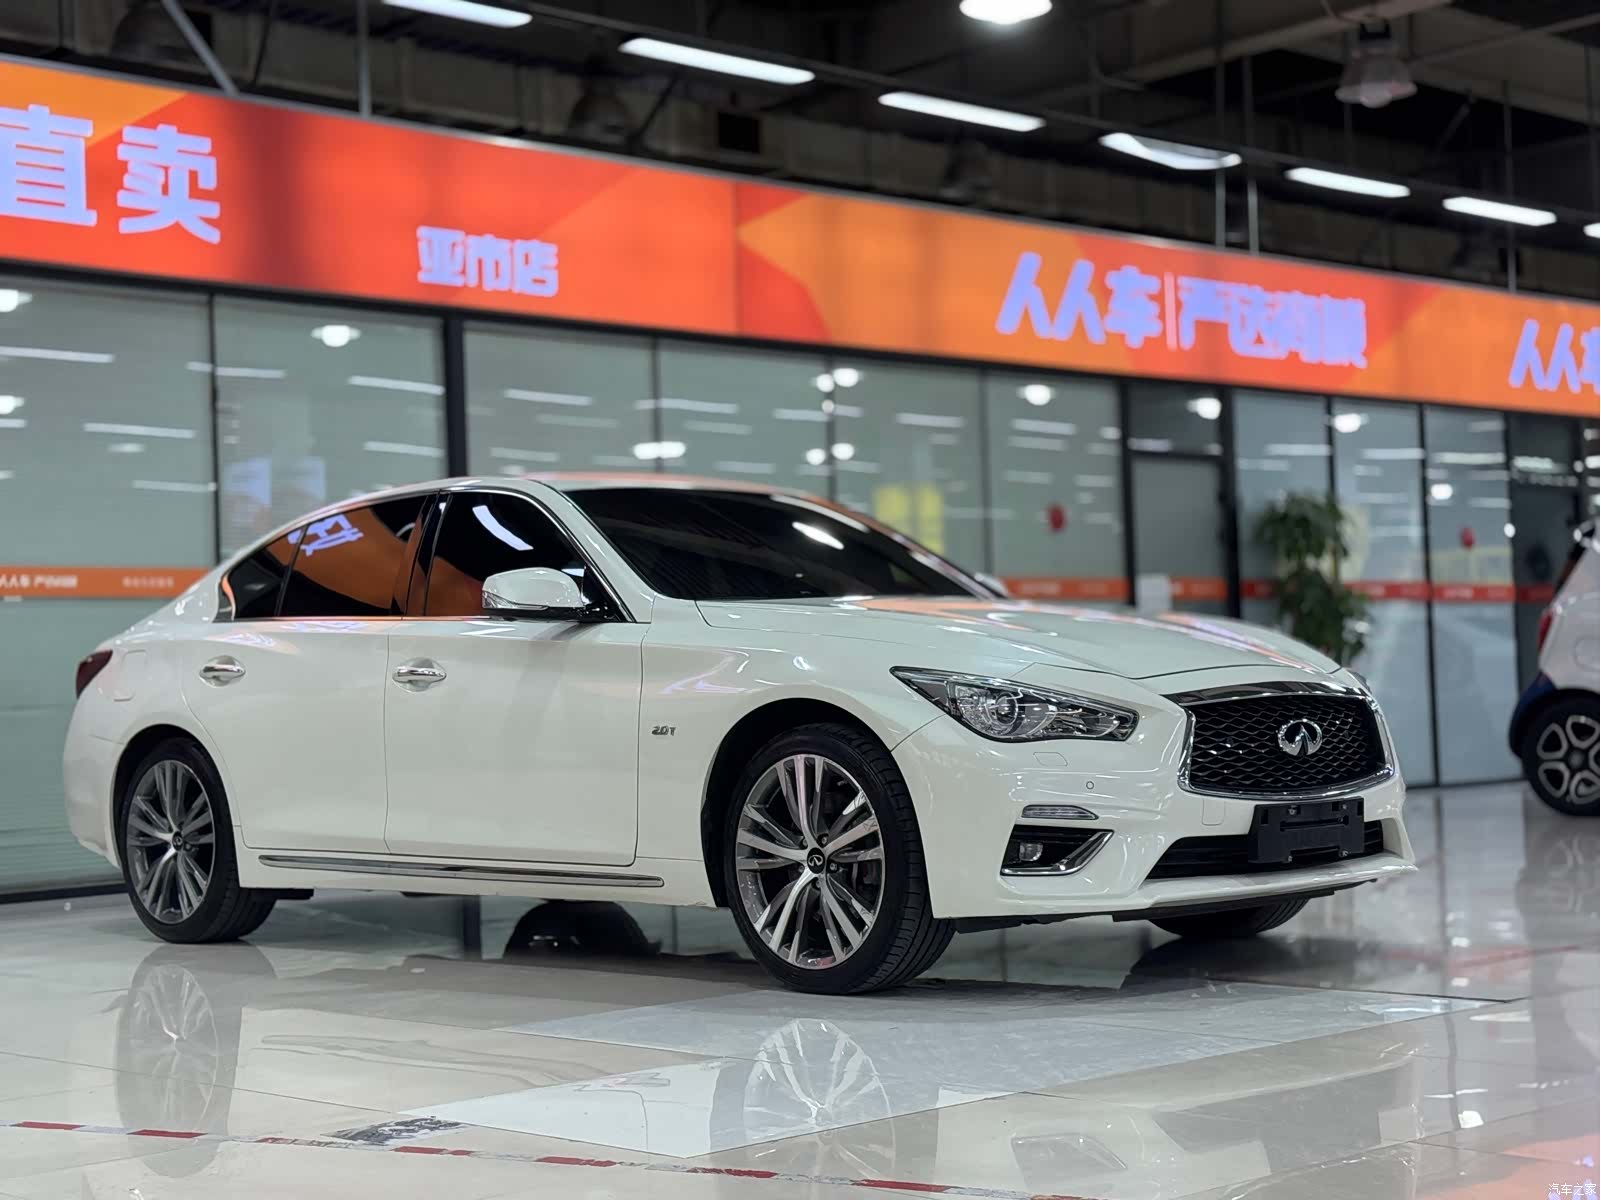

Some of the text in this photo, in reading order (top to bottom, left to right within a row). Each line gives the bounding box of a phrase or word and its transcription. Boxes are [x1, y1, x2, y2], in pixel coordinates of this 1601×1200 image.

[416, 225, 559, 297] 亚市店
[995, 251, 1163, 349] 人人车
